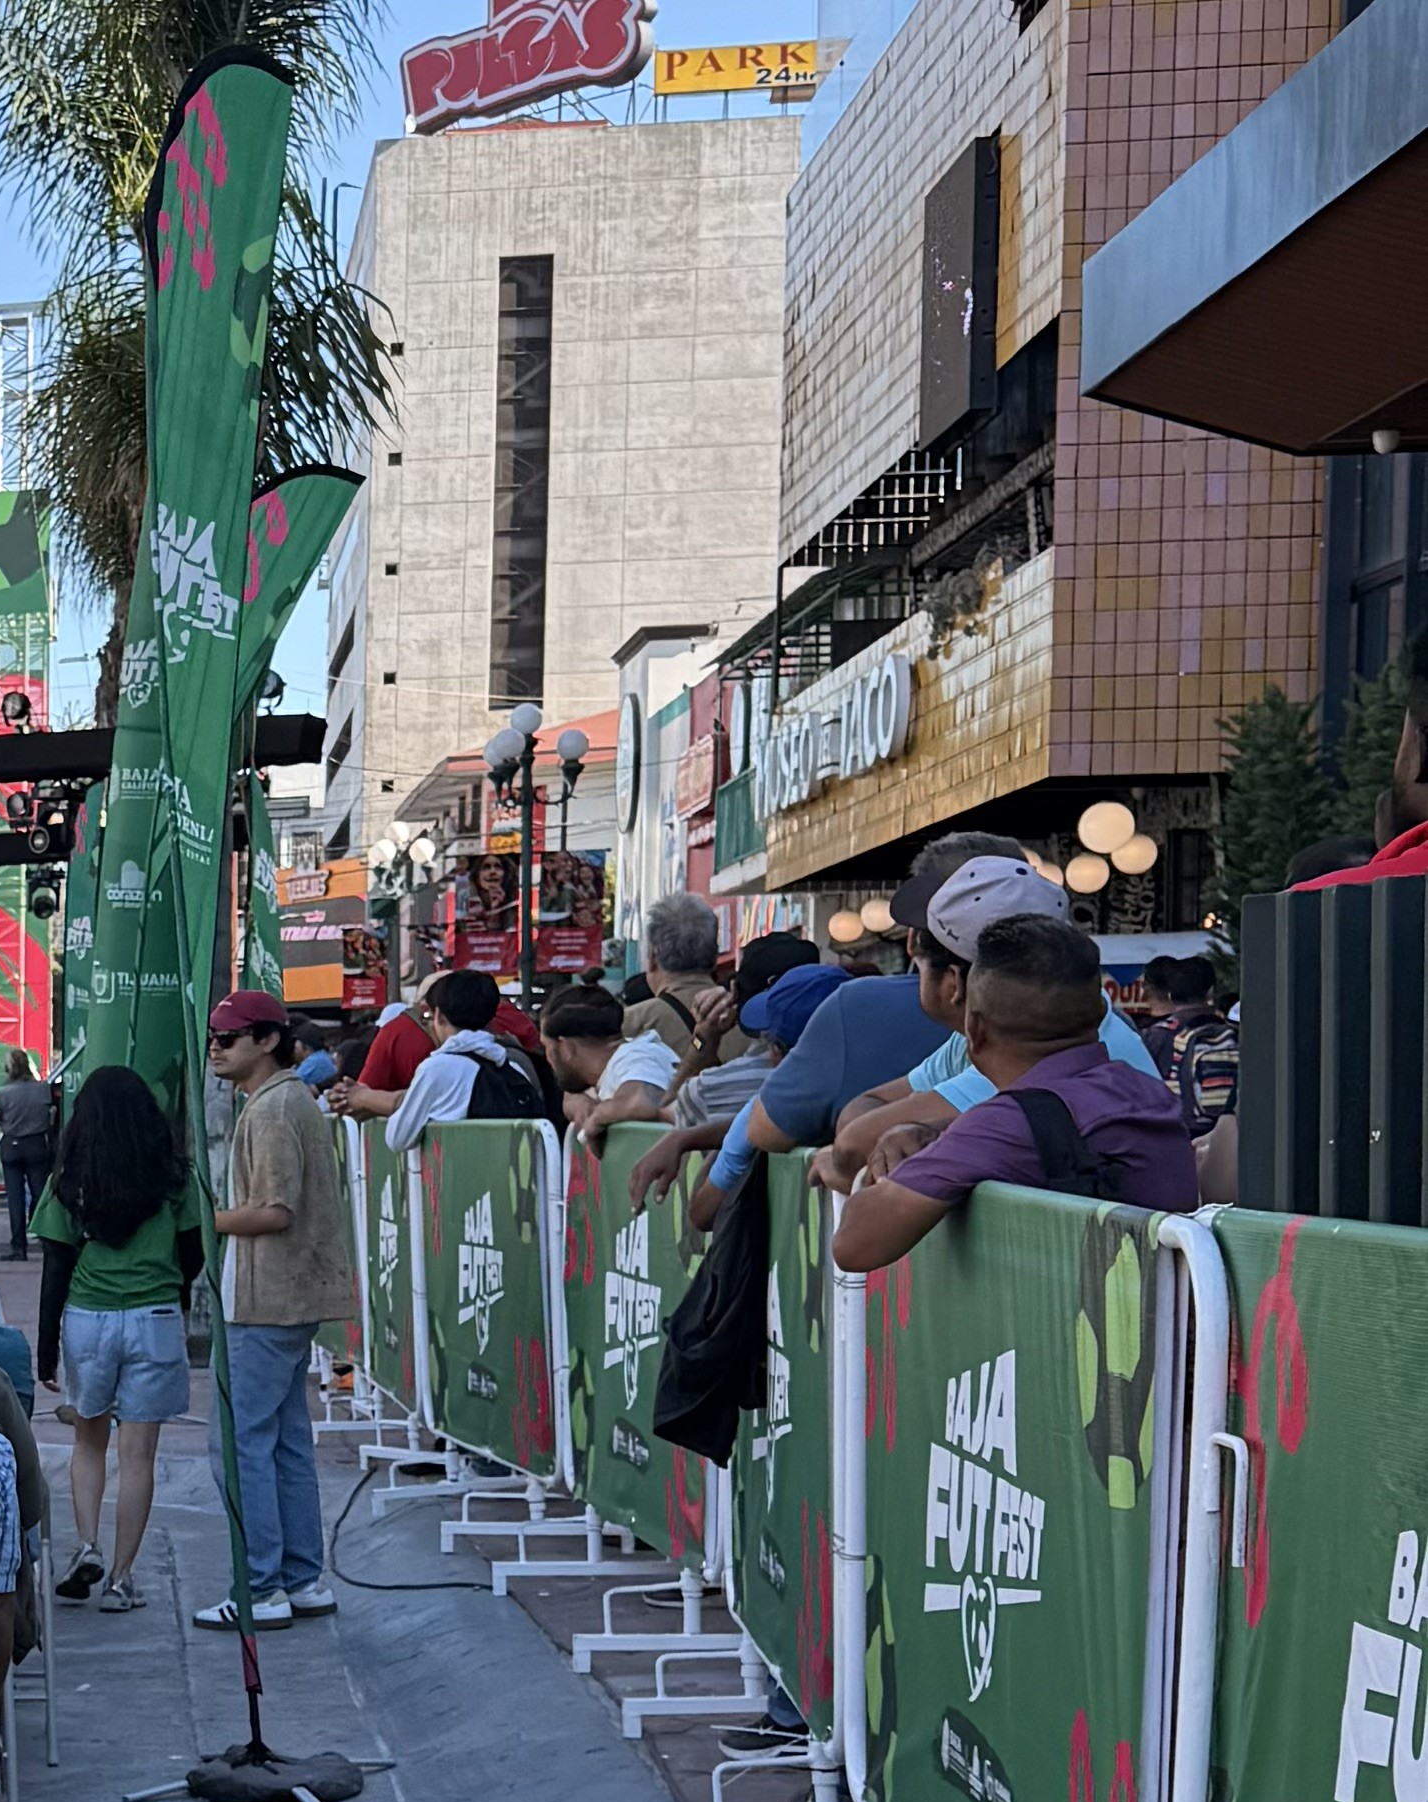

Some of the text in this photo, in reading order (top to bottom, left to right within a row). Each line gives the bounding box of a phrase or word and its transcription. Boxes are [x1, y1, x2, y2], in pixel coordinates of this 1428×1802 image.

[665, 42, 811, 82] PARK
[756, 67, 791, 84] 24
[838, 654, 900, 780] TACO
[944, 1349, 1018, 1478] BAJA
[925, 1441, 1046, 1581] FUT FEST
